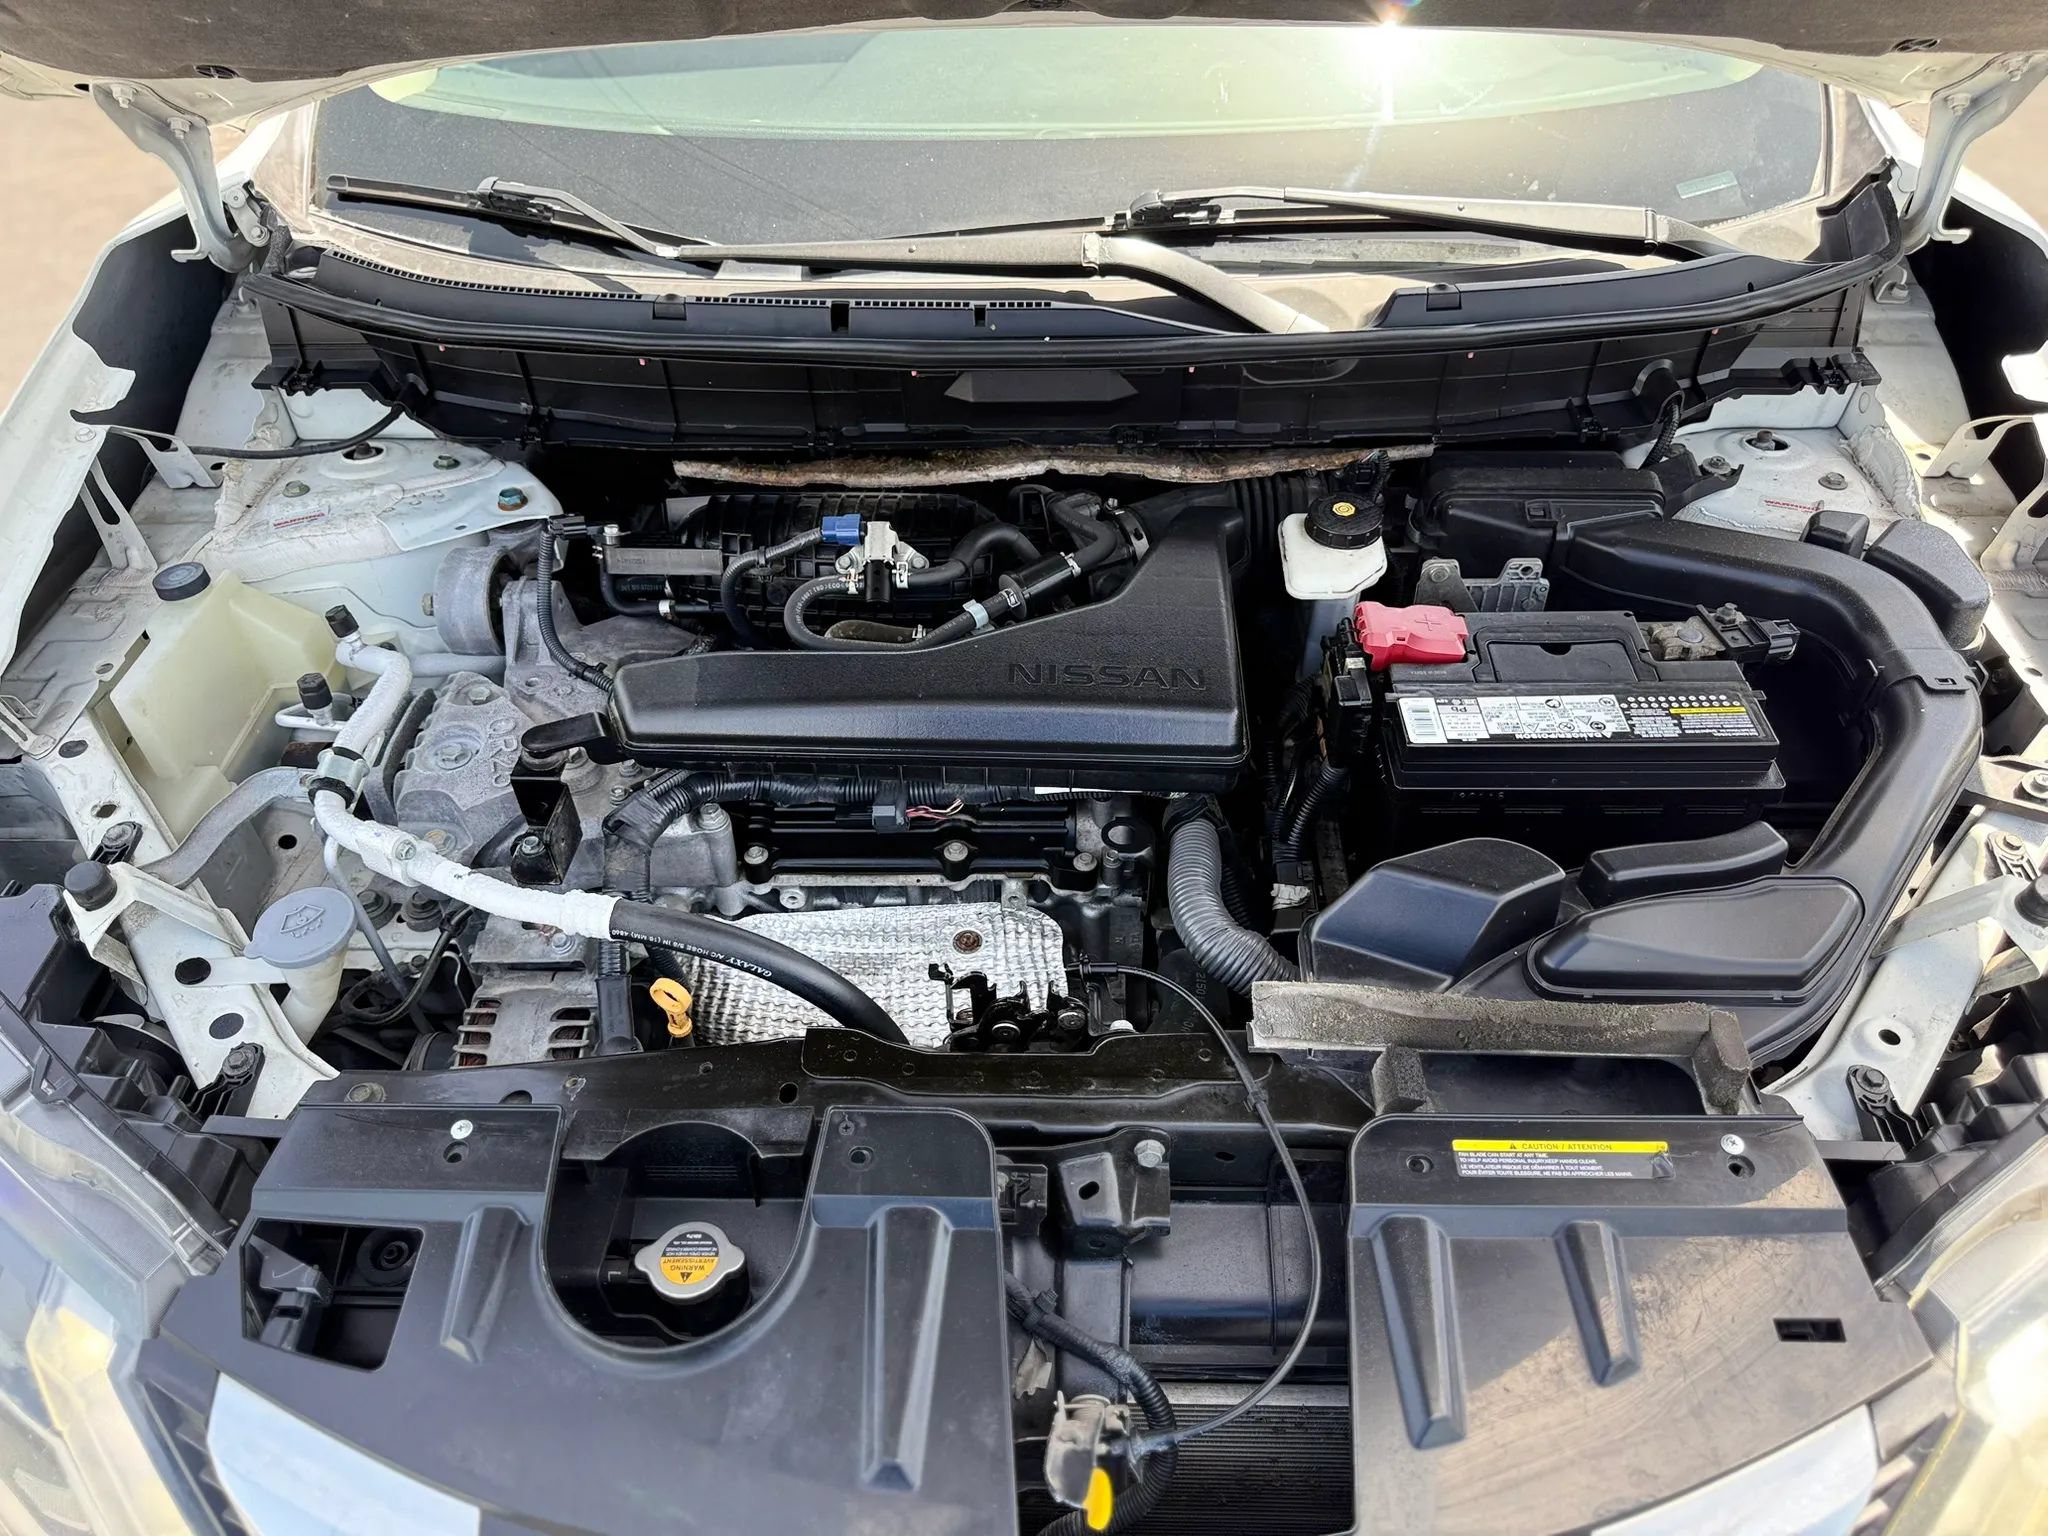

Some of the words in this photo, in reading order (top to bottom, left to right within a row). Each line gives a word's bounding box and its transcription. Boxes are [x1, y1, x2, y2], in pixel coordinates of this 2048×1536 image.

[1008, 664, 1206, 690] NISSAN
[631, 931, 647, 940] MM)
[686, 944, 709, 956] HOSE
[711, 951, 725, 959] A/C
[726, 956, 772, 977] GALAXY
